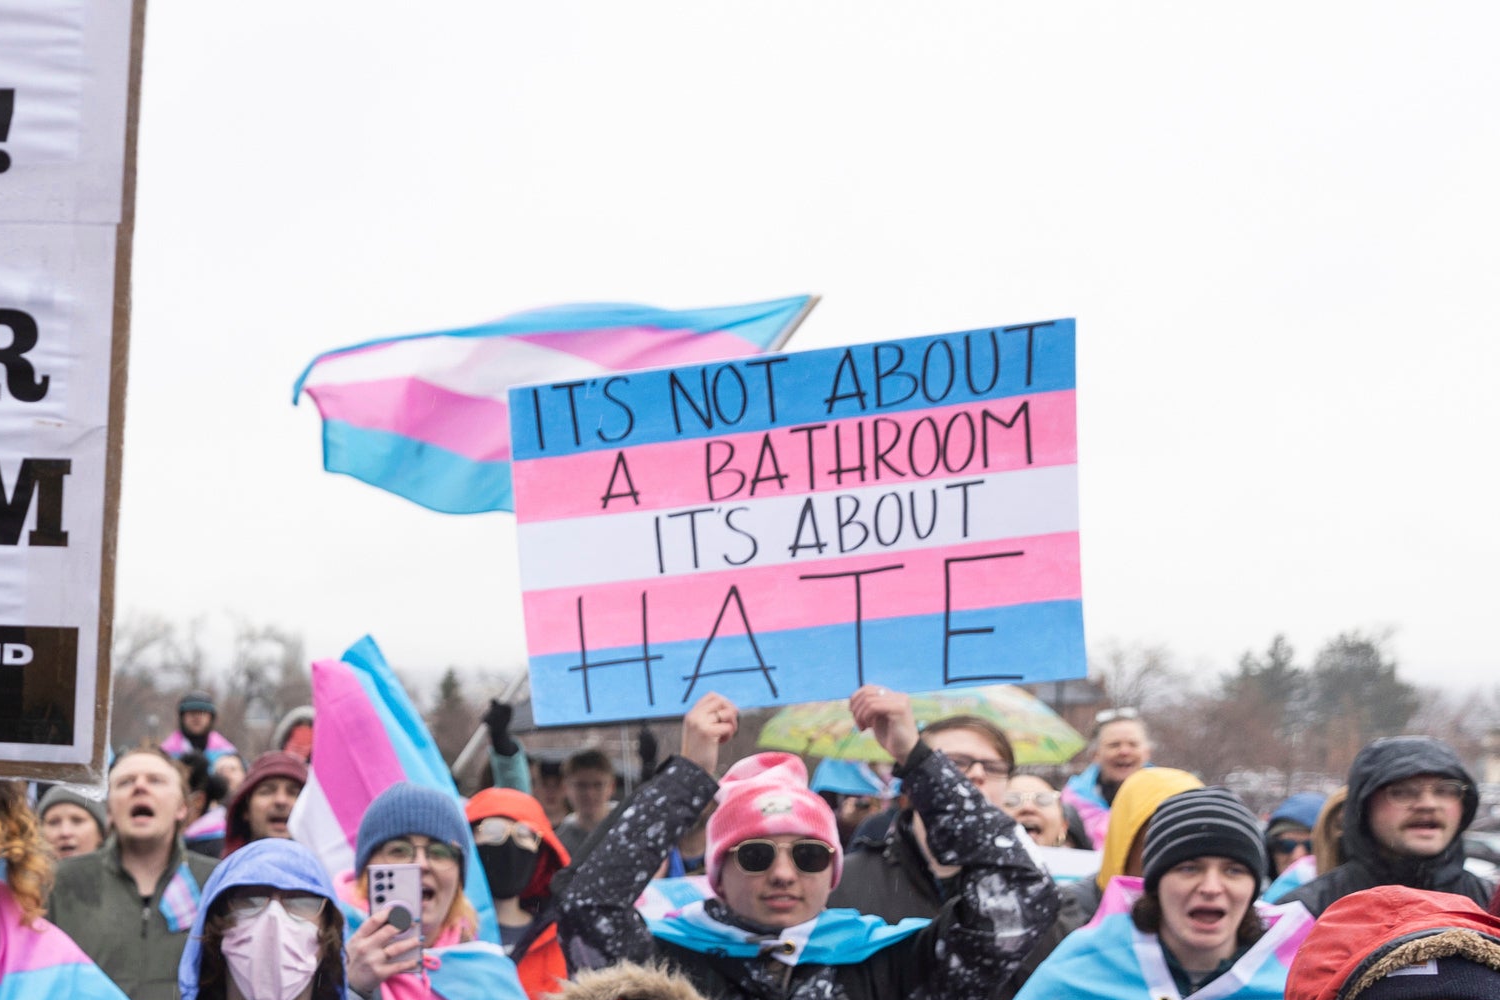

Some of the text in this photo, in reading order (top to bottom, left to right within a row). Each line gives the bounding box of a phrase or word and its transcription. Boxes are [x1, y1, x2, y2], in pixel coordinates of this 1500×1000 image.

[532, 321, 1056, 451] IT'S NOT ABOUT
[602, 401, 1034, 509] A BATHROOM
[654, 480, 985, 573] IT'S ABOUT
[568, 551, 1024, 714] HATE
